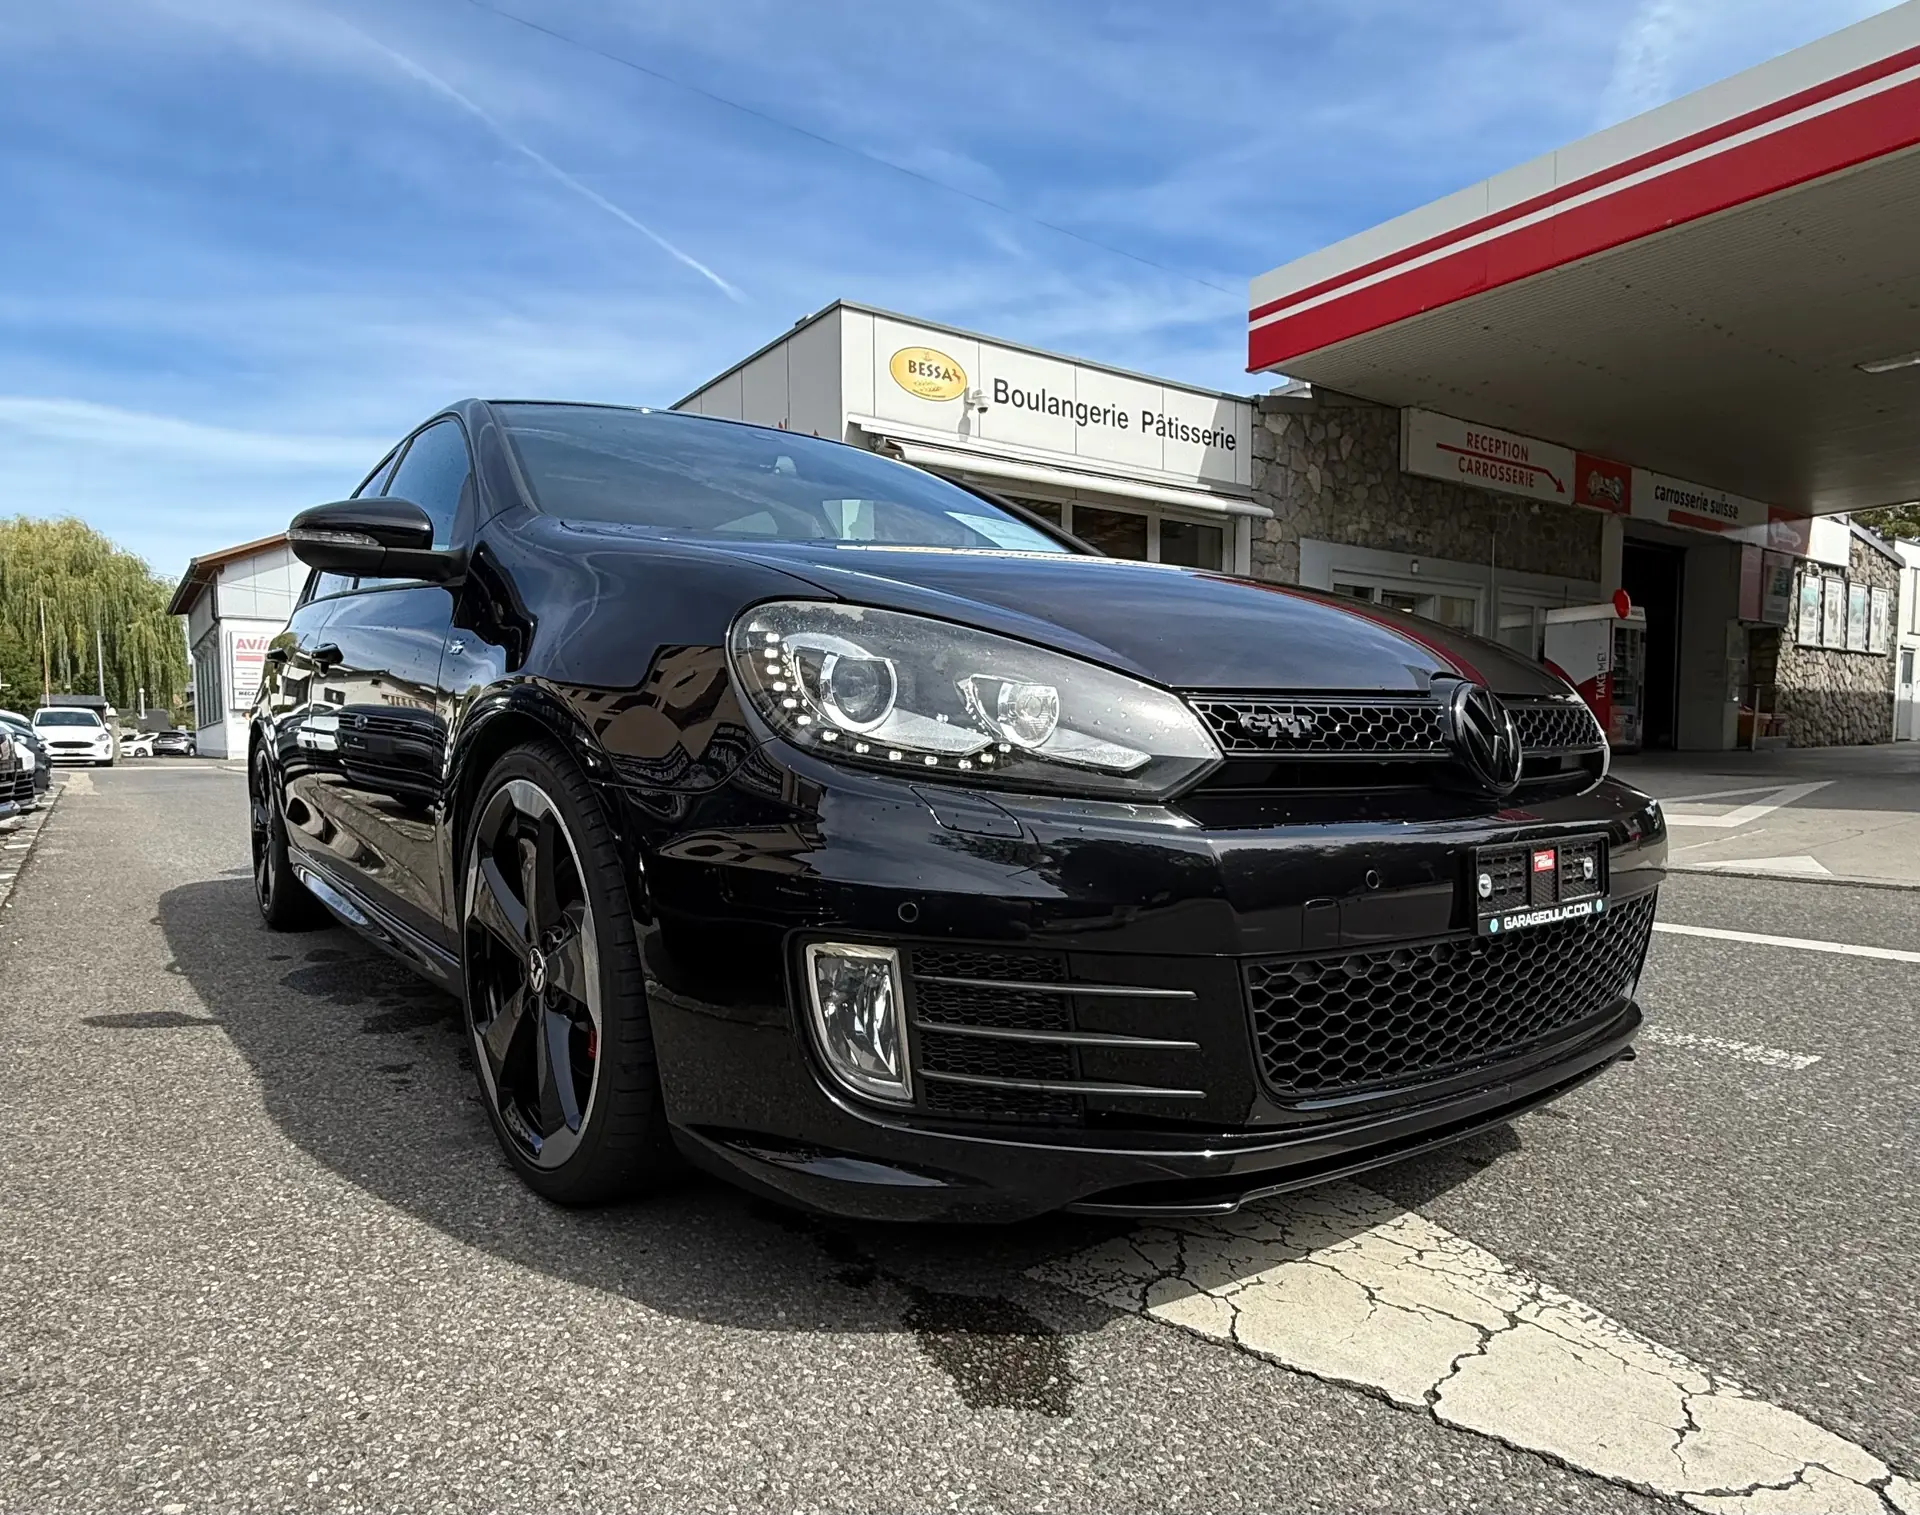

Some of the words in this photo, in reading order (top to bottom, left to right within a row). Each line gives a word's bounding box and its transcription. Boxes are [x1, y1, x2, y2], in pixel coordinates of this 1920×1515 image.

[908, 359, 953, 382] BESSA
[993, 378, 1129, 429] Boulangerie
[1141, 410, 1236, 451] Pâtisserie
[1466, 431, 1529, 462] RECEPTION
[1458, 456, 1535, 488] CARROSSERIE
[1654, 484, 1709, 512] carrosserie
[1709, 499, 1739, 520] suisse
[1596, 672, 1607, 700] TAKE
